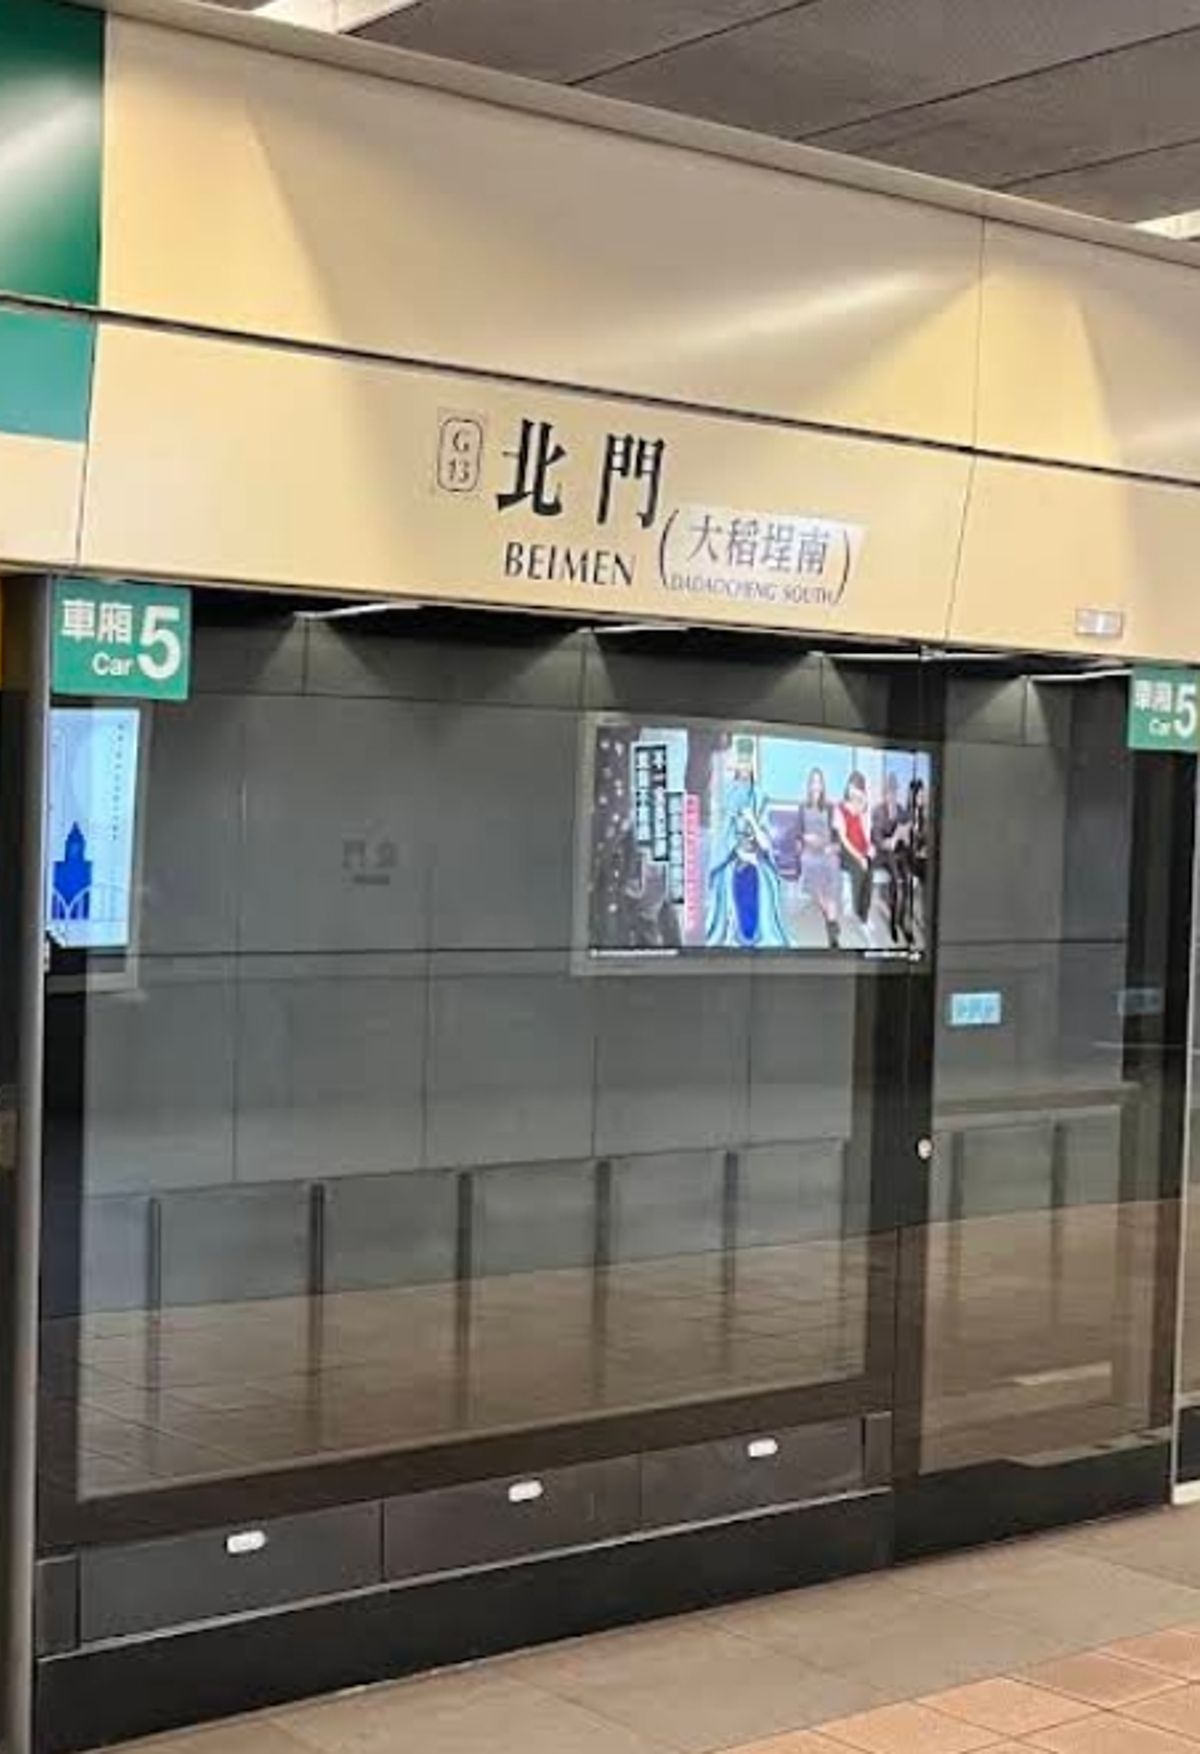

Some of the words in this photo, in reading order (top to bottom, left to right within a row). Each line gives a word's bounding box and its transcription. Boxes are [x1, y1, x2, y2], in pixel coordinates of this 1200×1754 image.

[452, 430, 471, 454] G
[447, 459, 471, 484] 13
[496, 418, 666, 529] 北門
[505, 541, 637, 587] BEIMEN
[61, 598, 133, 644] 車廂
[137, 604, 181, 680] 5
[91, 651, 134, 676] Car
[1173, 682, 1197, 738] 5
